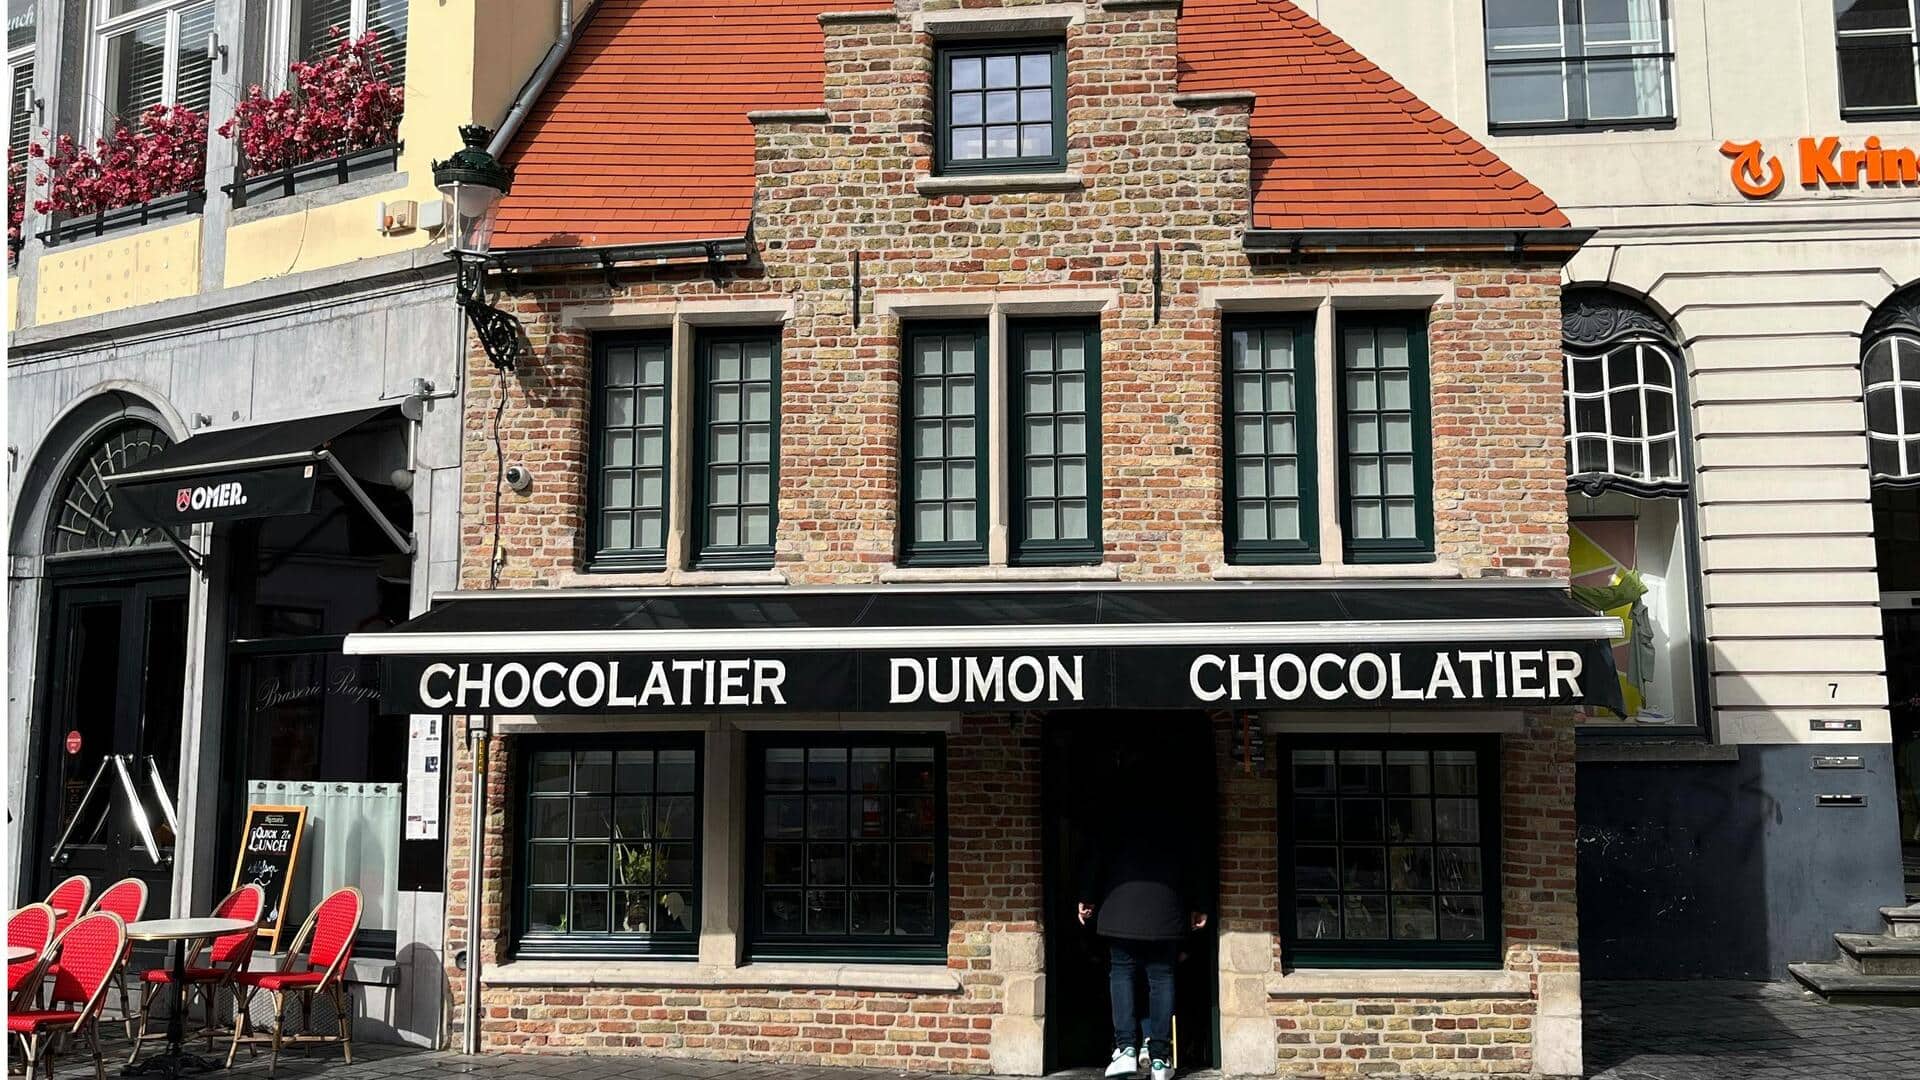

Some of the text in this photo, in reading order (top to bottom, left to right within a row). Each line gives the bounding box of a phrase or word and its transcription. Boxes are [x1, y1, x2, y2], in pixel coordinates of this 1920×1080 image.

[1798, 135, 1920, 185] Krin
[191, 482, 248, 511] OMER.
[419, 649, 1584, 708] CHOCOLATIER DUMON CHOCOLATIER
[1828, 683, 1838, 698] 7
[248, 829, 288, 852] LUNCH
